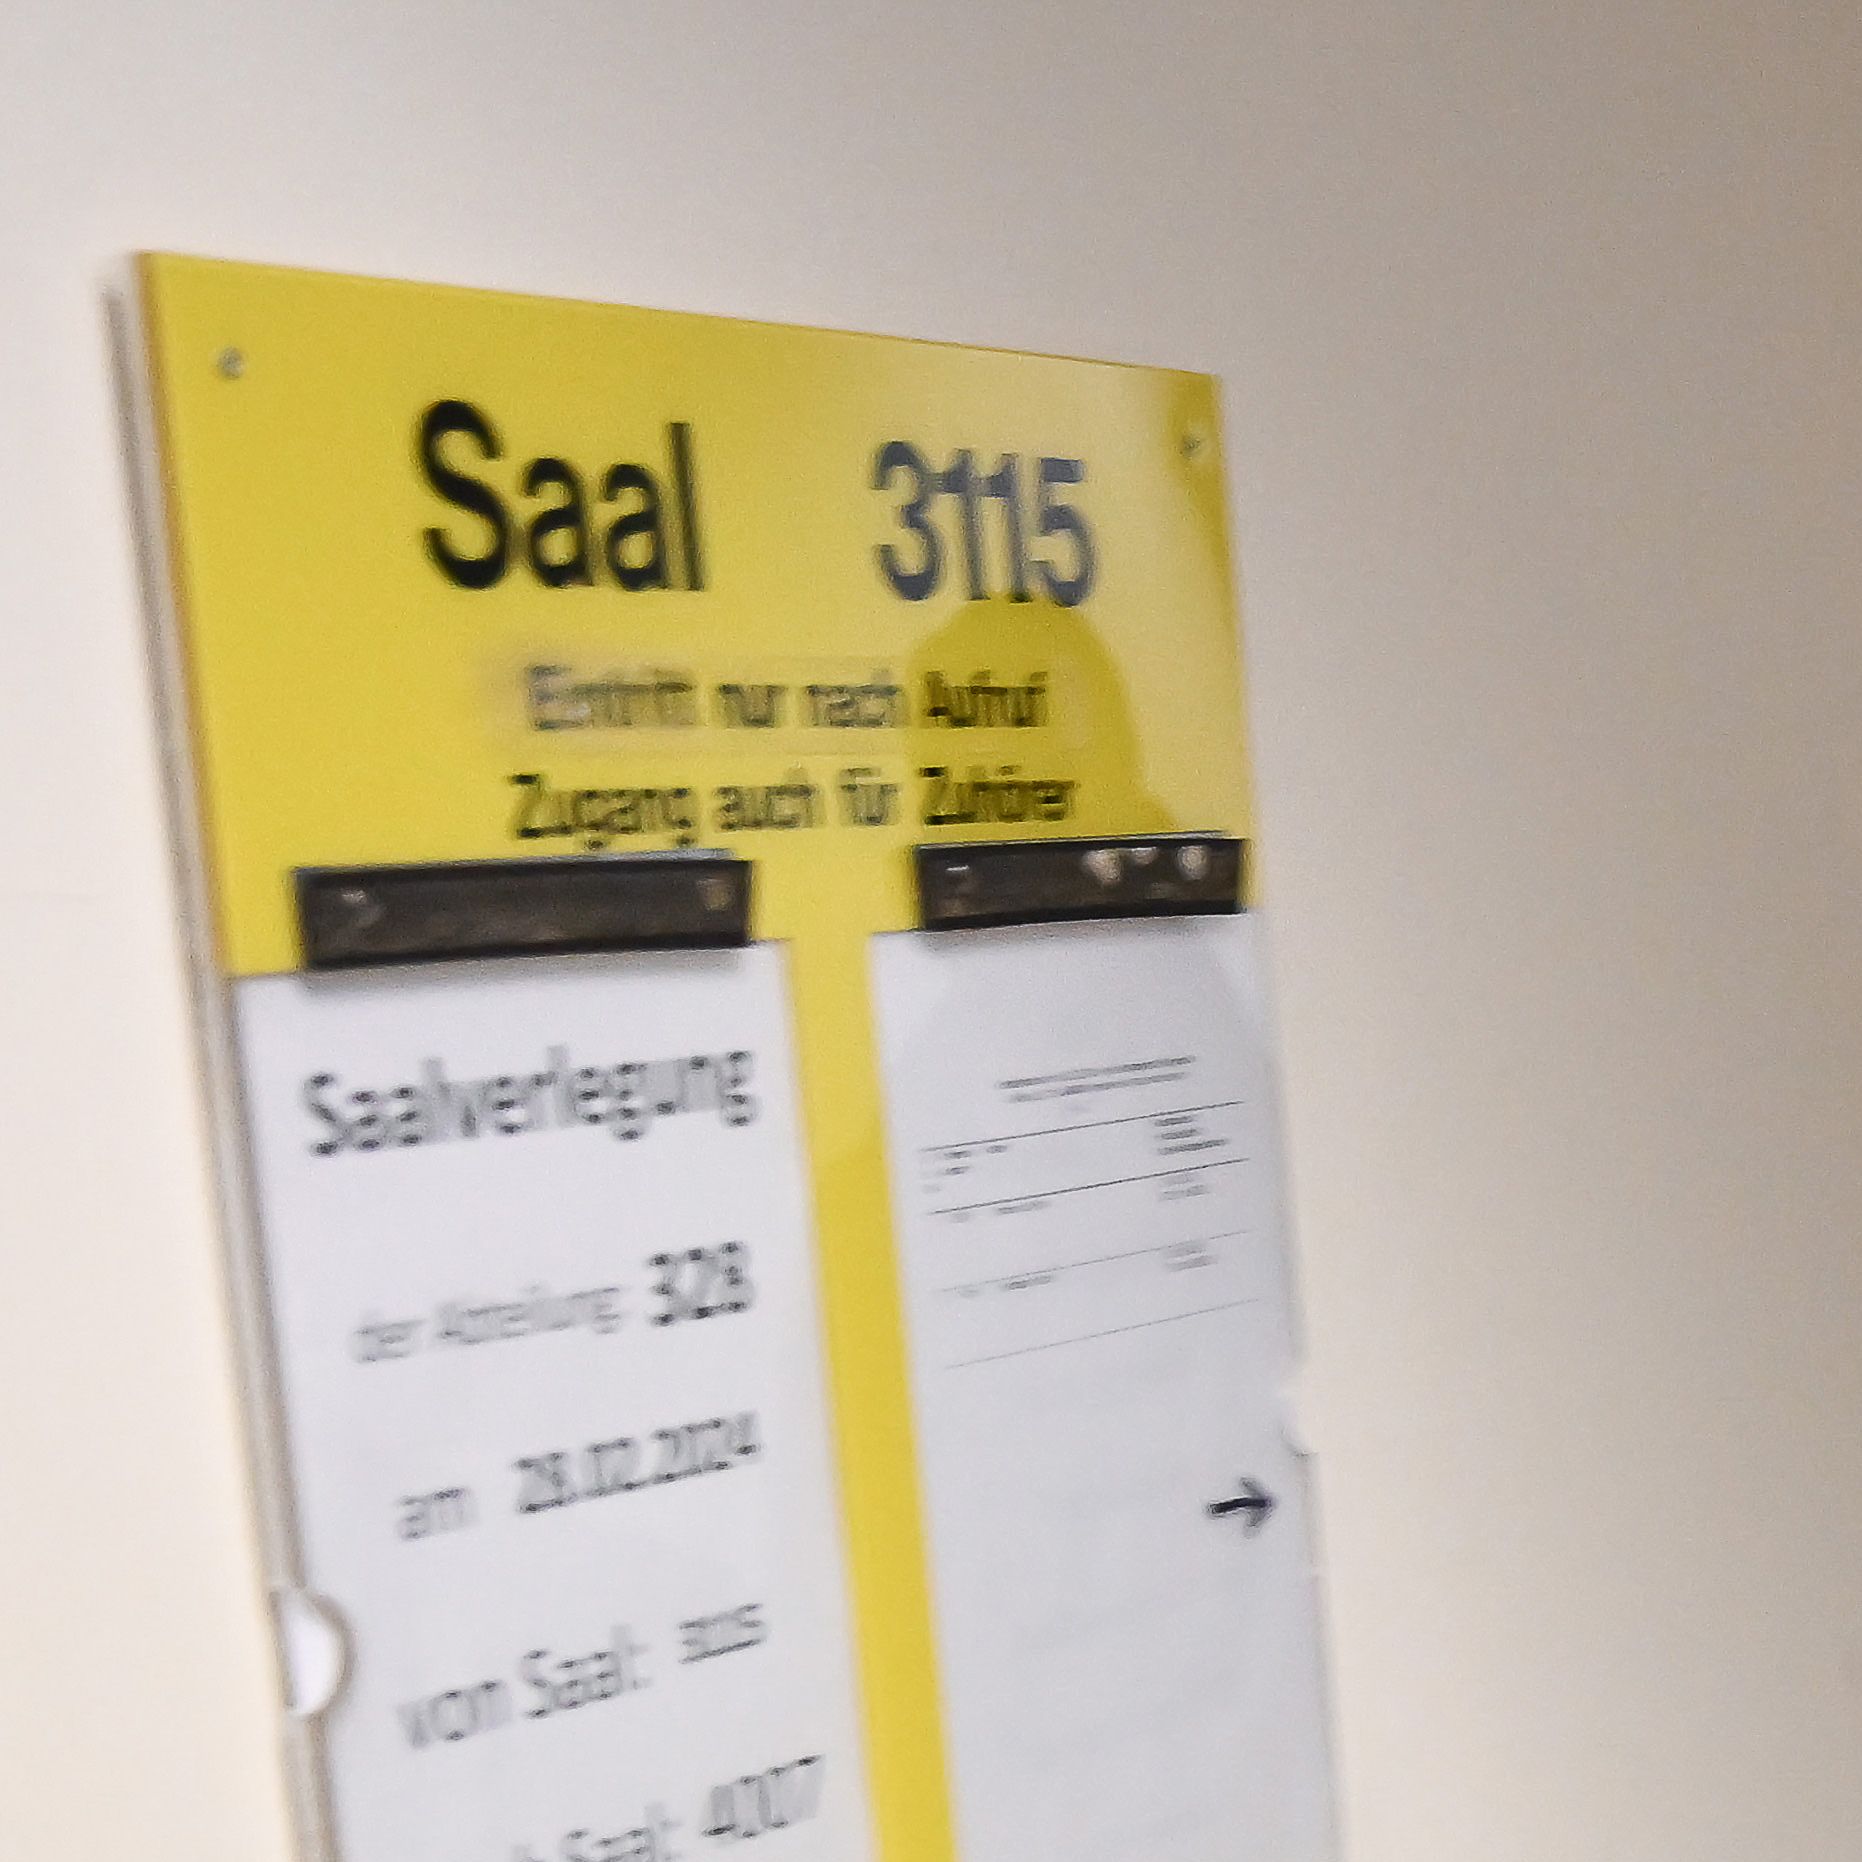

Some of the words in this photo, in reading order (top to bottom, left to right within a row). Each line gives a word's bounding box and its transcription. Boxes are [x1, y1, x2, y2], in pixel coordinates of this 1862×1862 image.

[415, 399, 706, 591] Saal
[872, 440, 1096, 607] 3115
[526, 664, 695, 730] Eintritt
[718, 681, 786, 729] nur
[804, 669, 905, 729] nach
[923, 669, 1049, 729] Aufruf
[507, 773, 697, 850] Zugang
[715, 766, 828, 831] auch
[838, 765, 902, 827] für
[918, 763, 1080, 827] Zuhörer
[304, 1045, 758, 1155] Saalverlegung
[346, 1307, 427, 1364] der
[434, 1281, 622, 1348] Abteilung
[648, 1240, 757, 1327] 328
[397, 1486, 478, 1543] am
[396, 1679, 513, 1752] von
[699, 1752, 827, 1841] 4007
